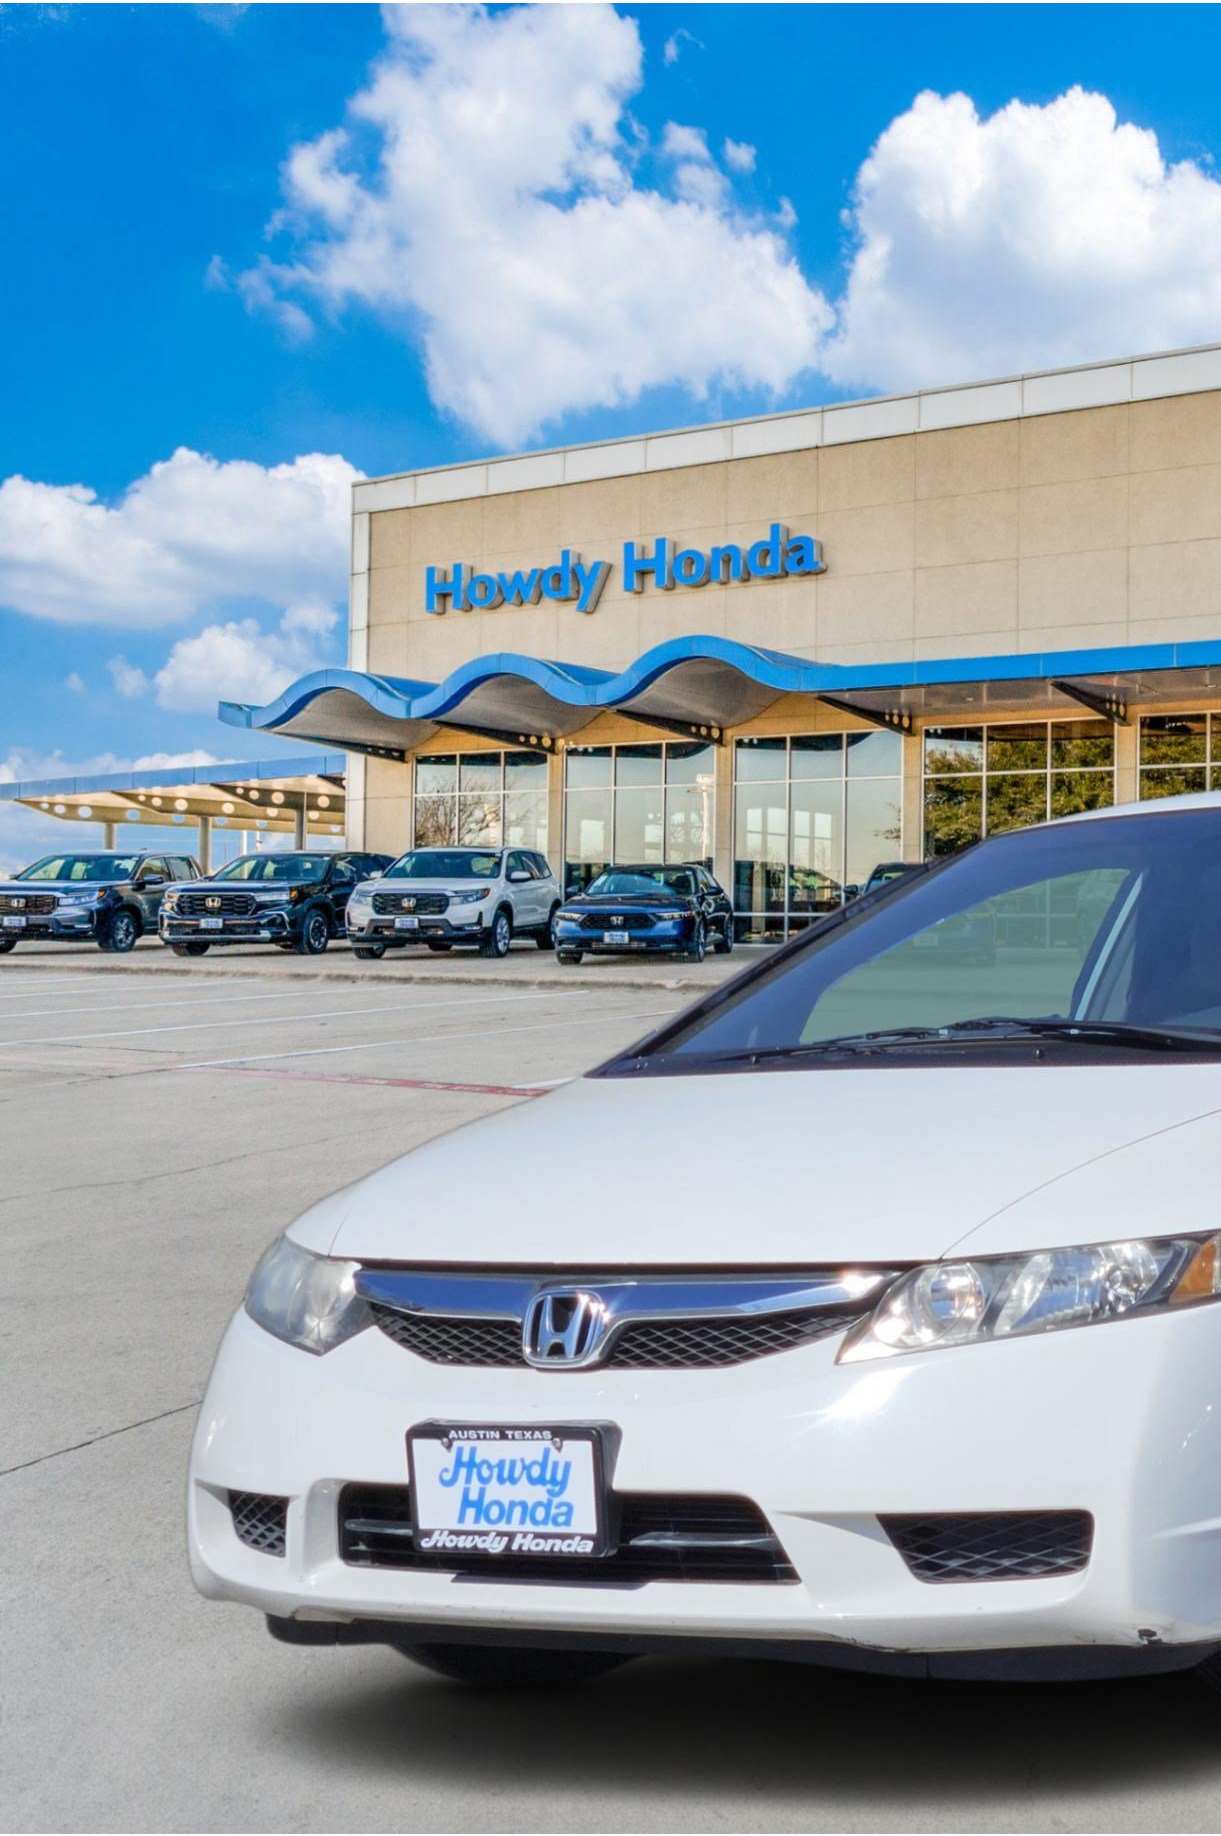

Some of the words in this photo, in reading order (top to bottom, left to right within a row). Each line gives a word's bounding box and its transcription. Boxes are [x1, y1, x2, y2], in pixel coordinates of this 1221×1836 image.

[425, 548, 612, 615] Howdy
[623, 522, 828, 594] Honda
[449, 1430, 500, 1440] AUSTIN
[505, 1431, 552, 1440] TEXAS
[439, 1446, 572, 1498] Howdy
[457, 1486, 574, 1527] Honda
[420, 1529, 508, 1554] Howdy
[511, 1534, 594, 1553] Honda
